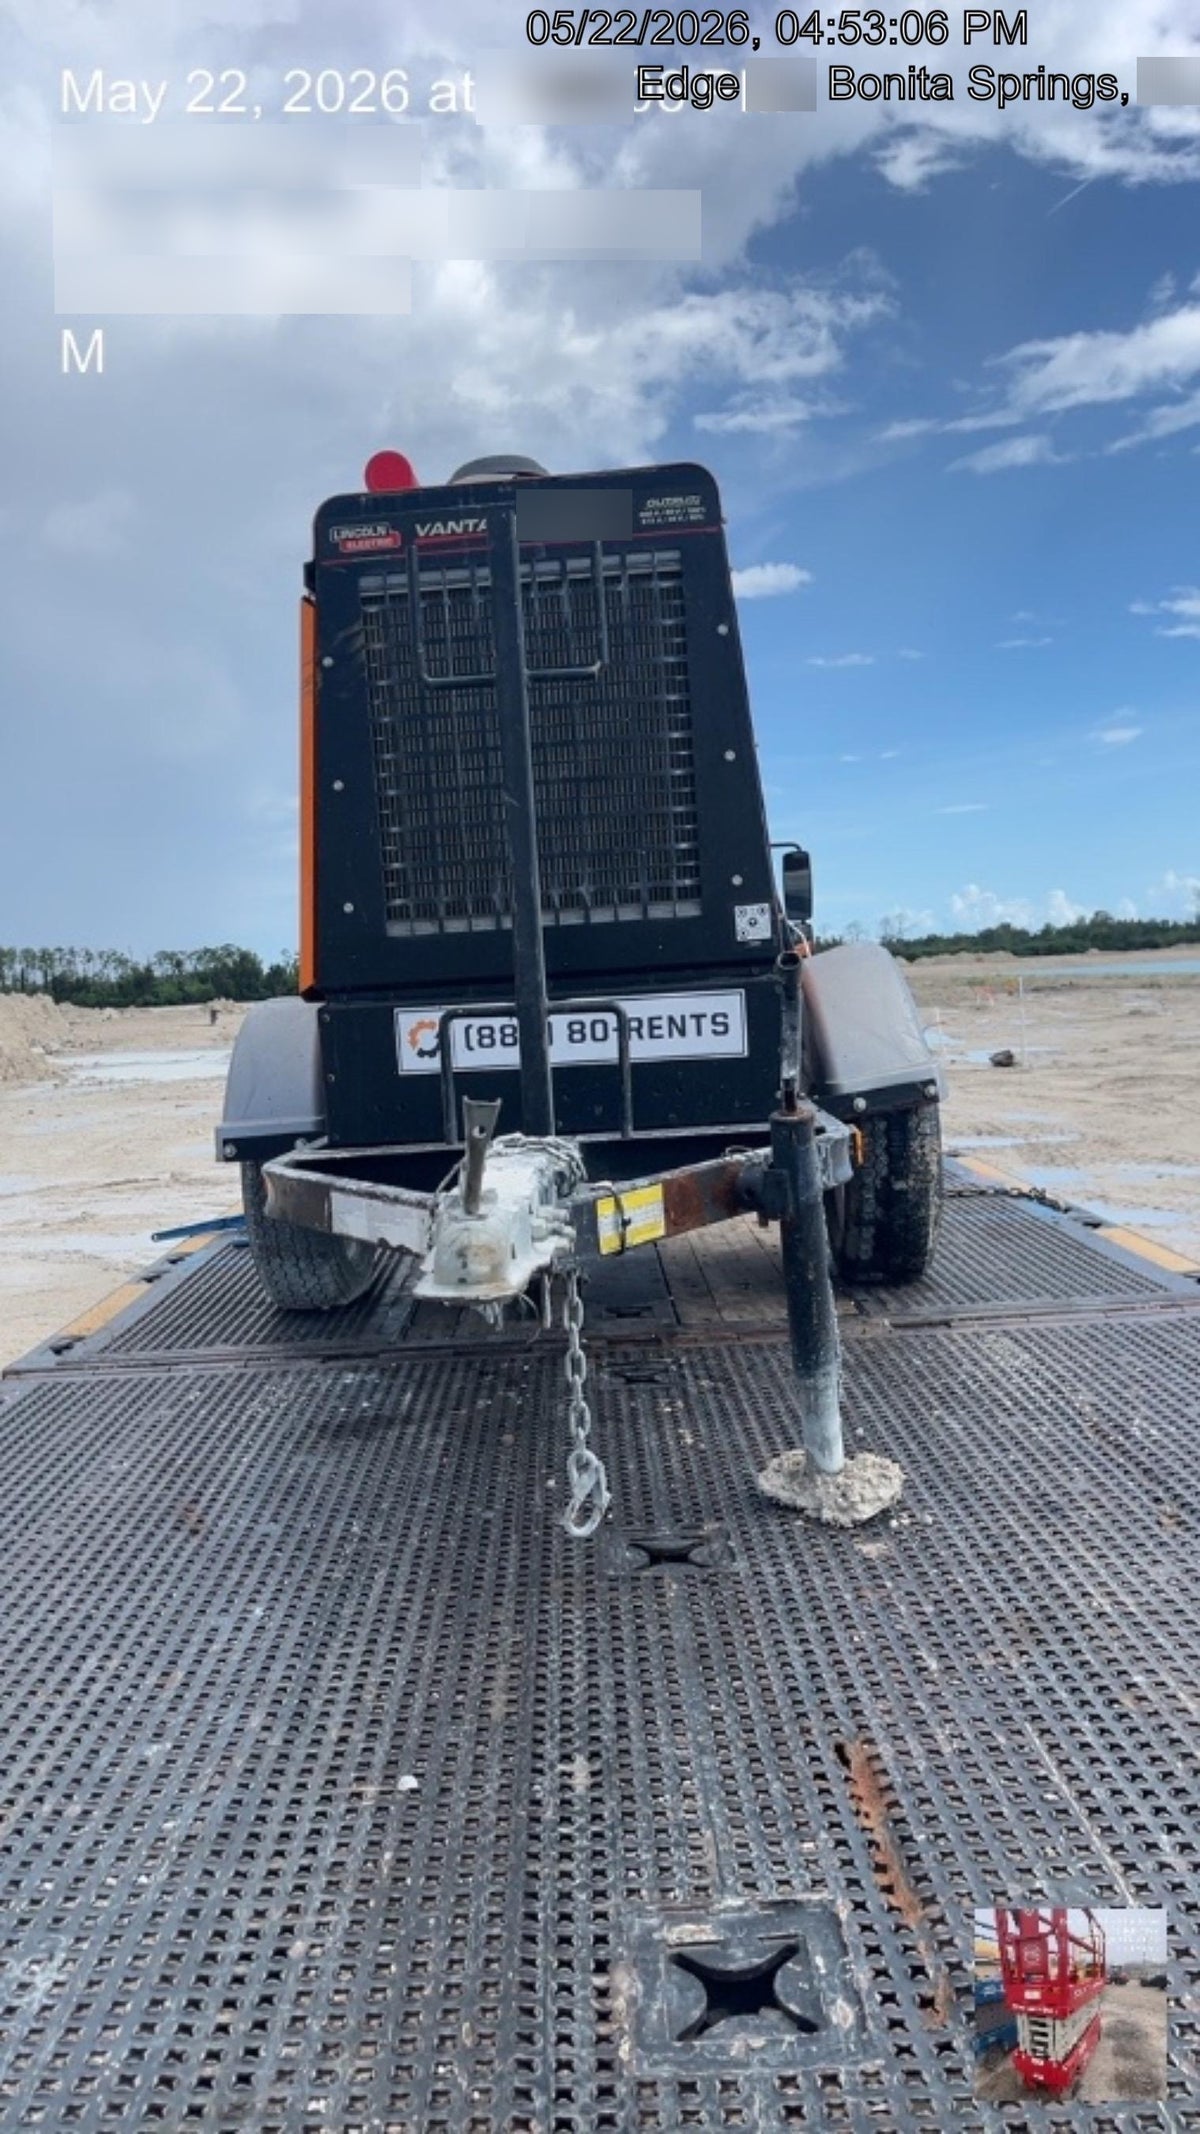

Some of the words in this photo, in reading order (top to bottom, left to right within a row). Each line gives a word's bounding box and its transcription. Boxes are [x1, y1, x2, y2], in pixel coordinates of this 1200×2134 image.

[333, 524, 386, 540] LINCOLN
[414, 518, 488, 537] VANTA
[463, 1020, 554, 1051] (88)
